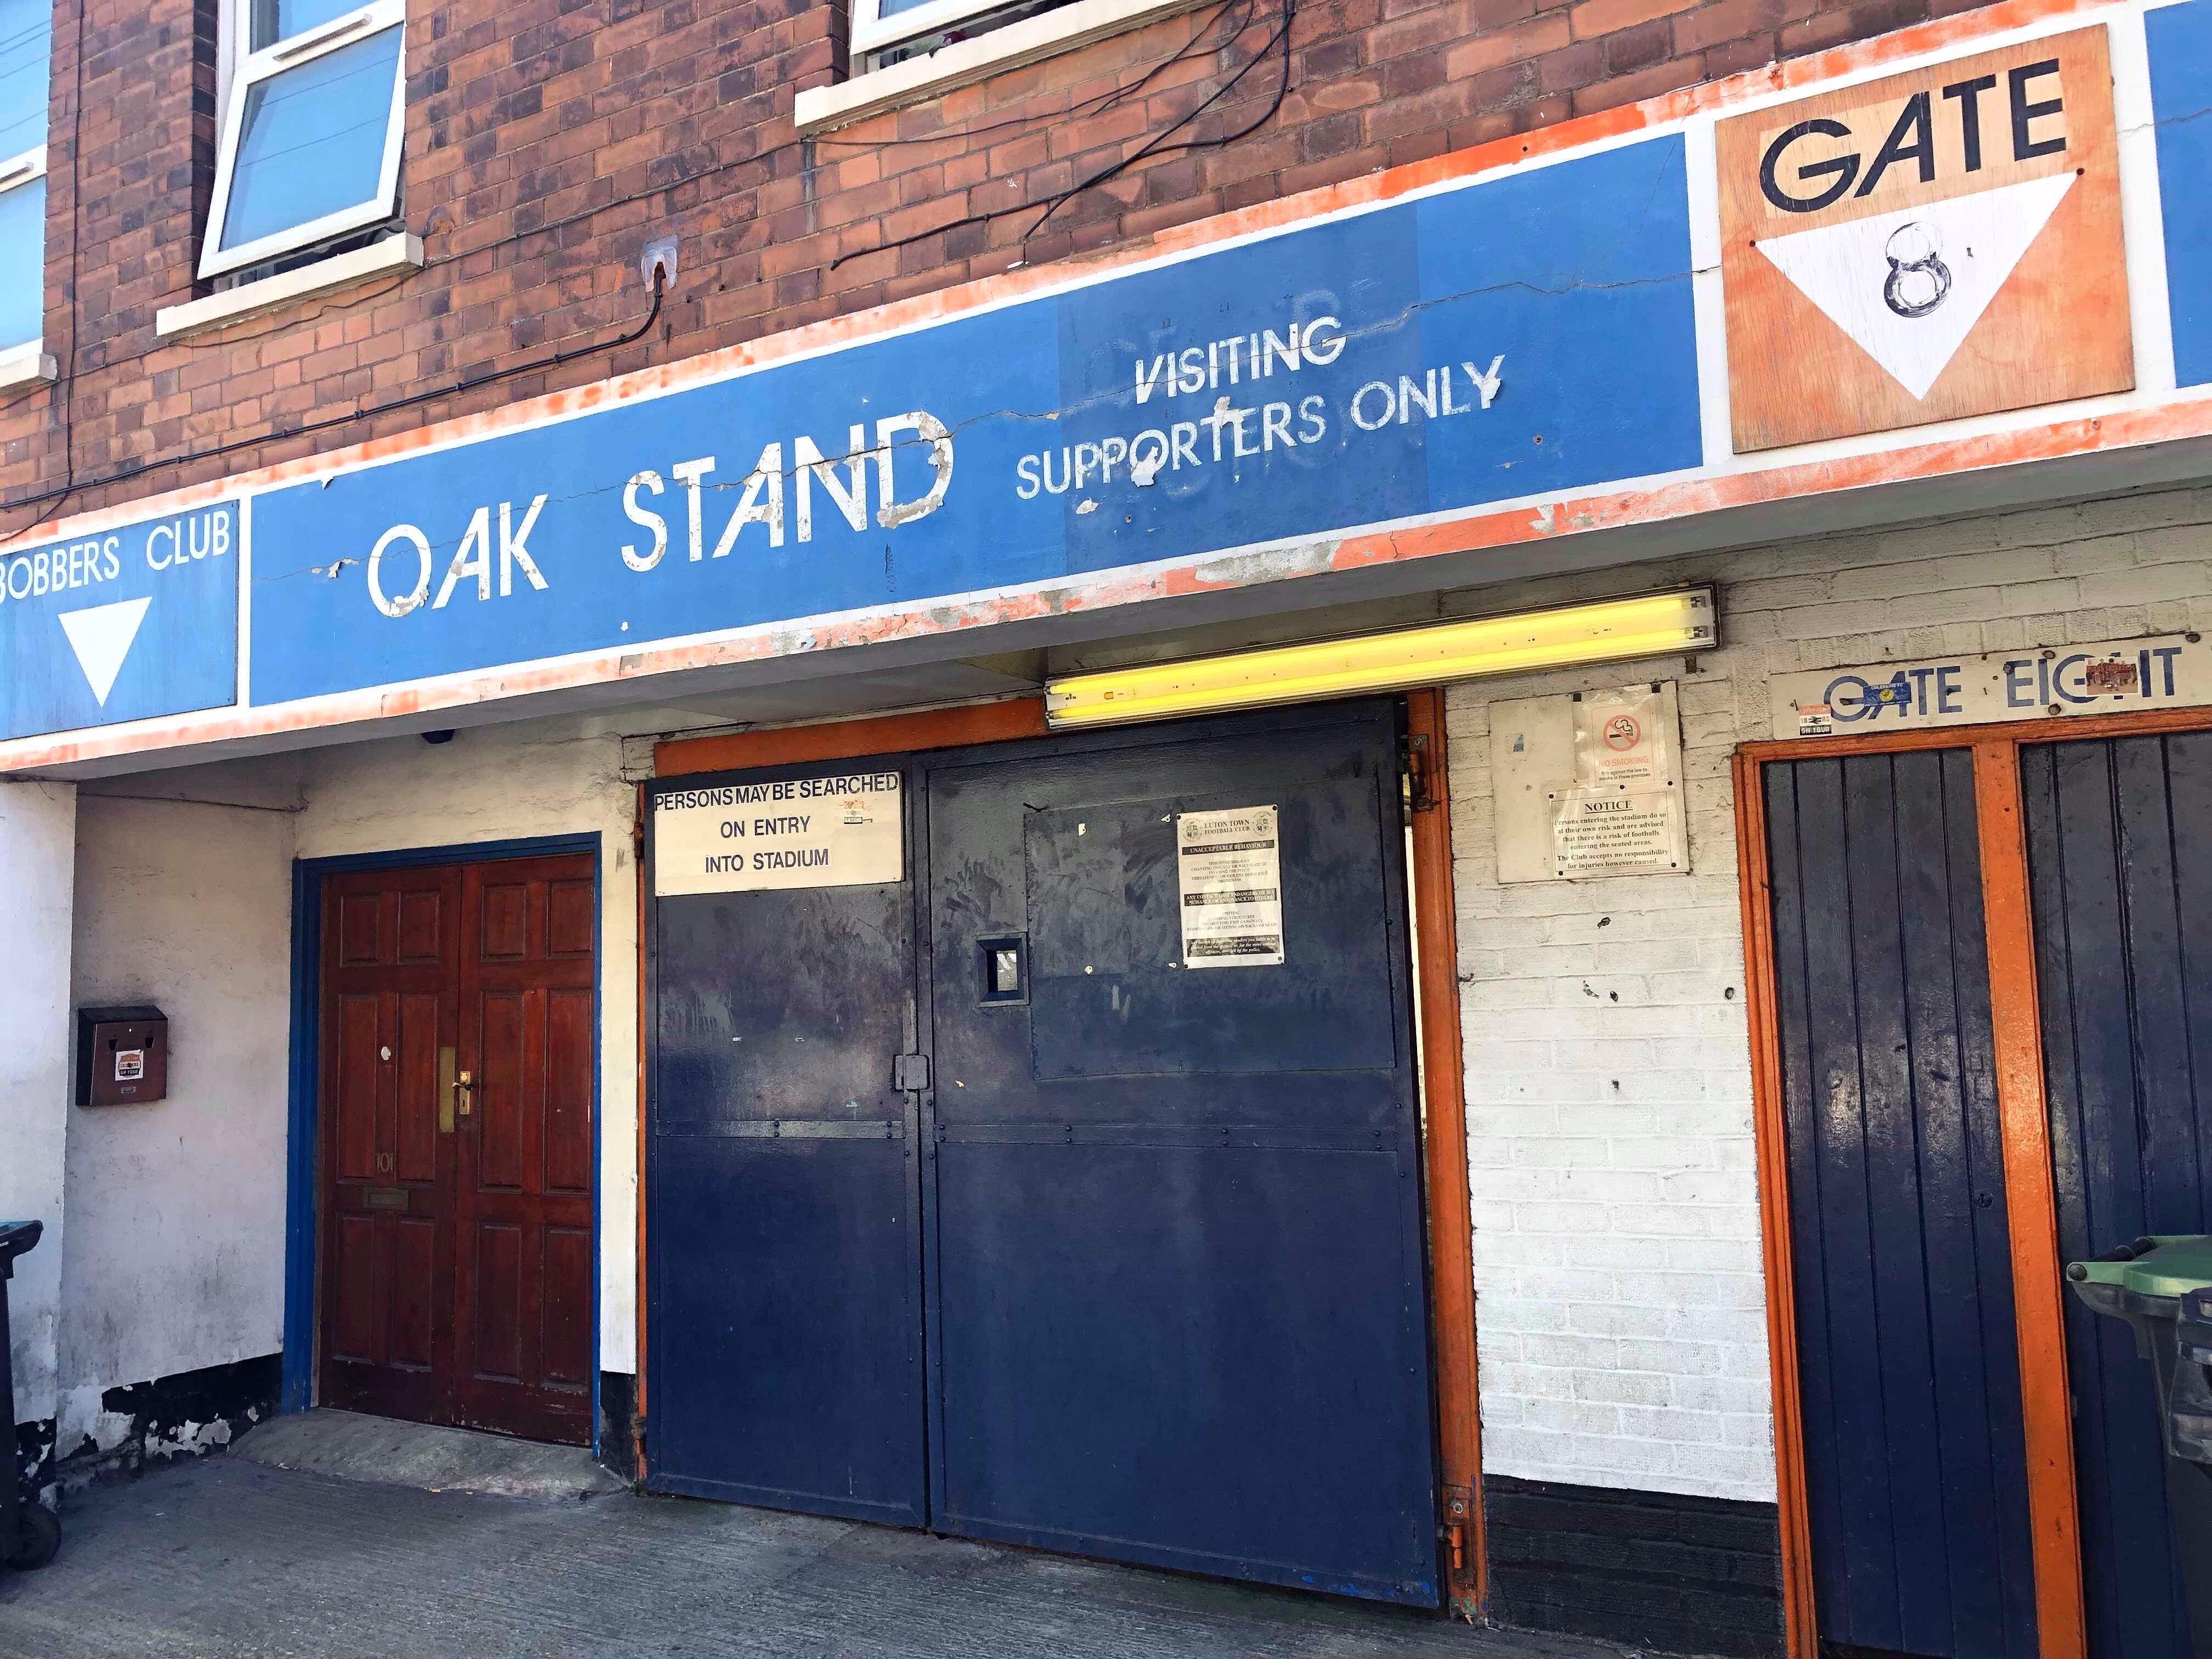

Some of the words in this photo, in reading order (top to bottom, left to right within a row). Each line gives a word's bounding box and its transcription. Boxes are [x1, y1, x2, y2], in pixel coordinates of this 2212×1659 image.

[1759, 58, 2067, 213] GATE
[1884, 222, 1951, 318] 8
[1135, 316, 1347, 404] VISITING
[1016, 396, 1326, 500] SUPPORTERS
[1351, 354, 1505, 430] ONLY
[368, 494, 549, 617] OAK
[621, 410, 955, 572] STAND
[146, 510, 230, 571] CLUB
[1824, 666, 1962, 722] GATE
[655, 789, 734, 811] PERSONS
[736, 785, 770, 804] MAY
[773, 783, 795, 800] BE
[800, 774, 898, 798] SEARCHED
[1585, 800, 1633, 812] NOTICE
[721, 821, 744, 838] ON
[754, 816, 811, 836] ENTRY
[1189, 845, 1232, 853] UNACCEPTABLE
[706, 855, 743, 873] INTO
[753, 849, 828, 870] STADIUM
[1578, 861, 1604, 870] injuries
[1624, 848, 1668, 857] responsibility
